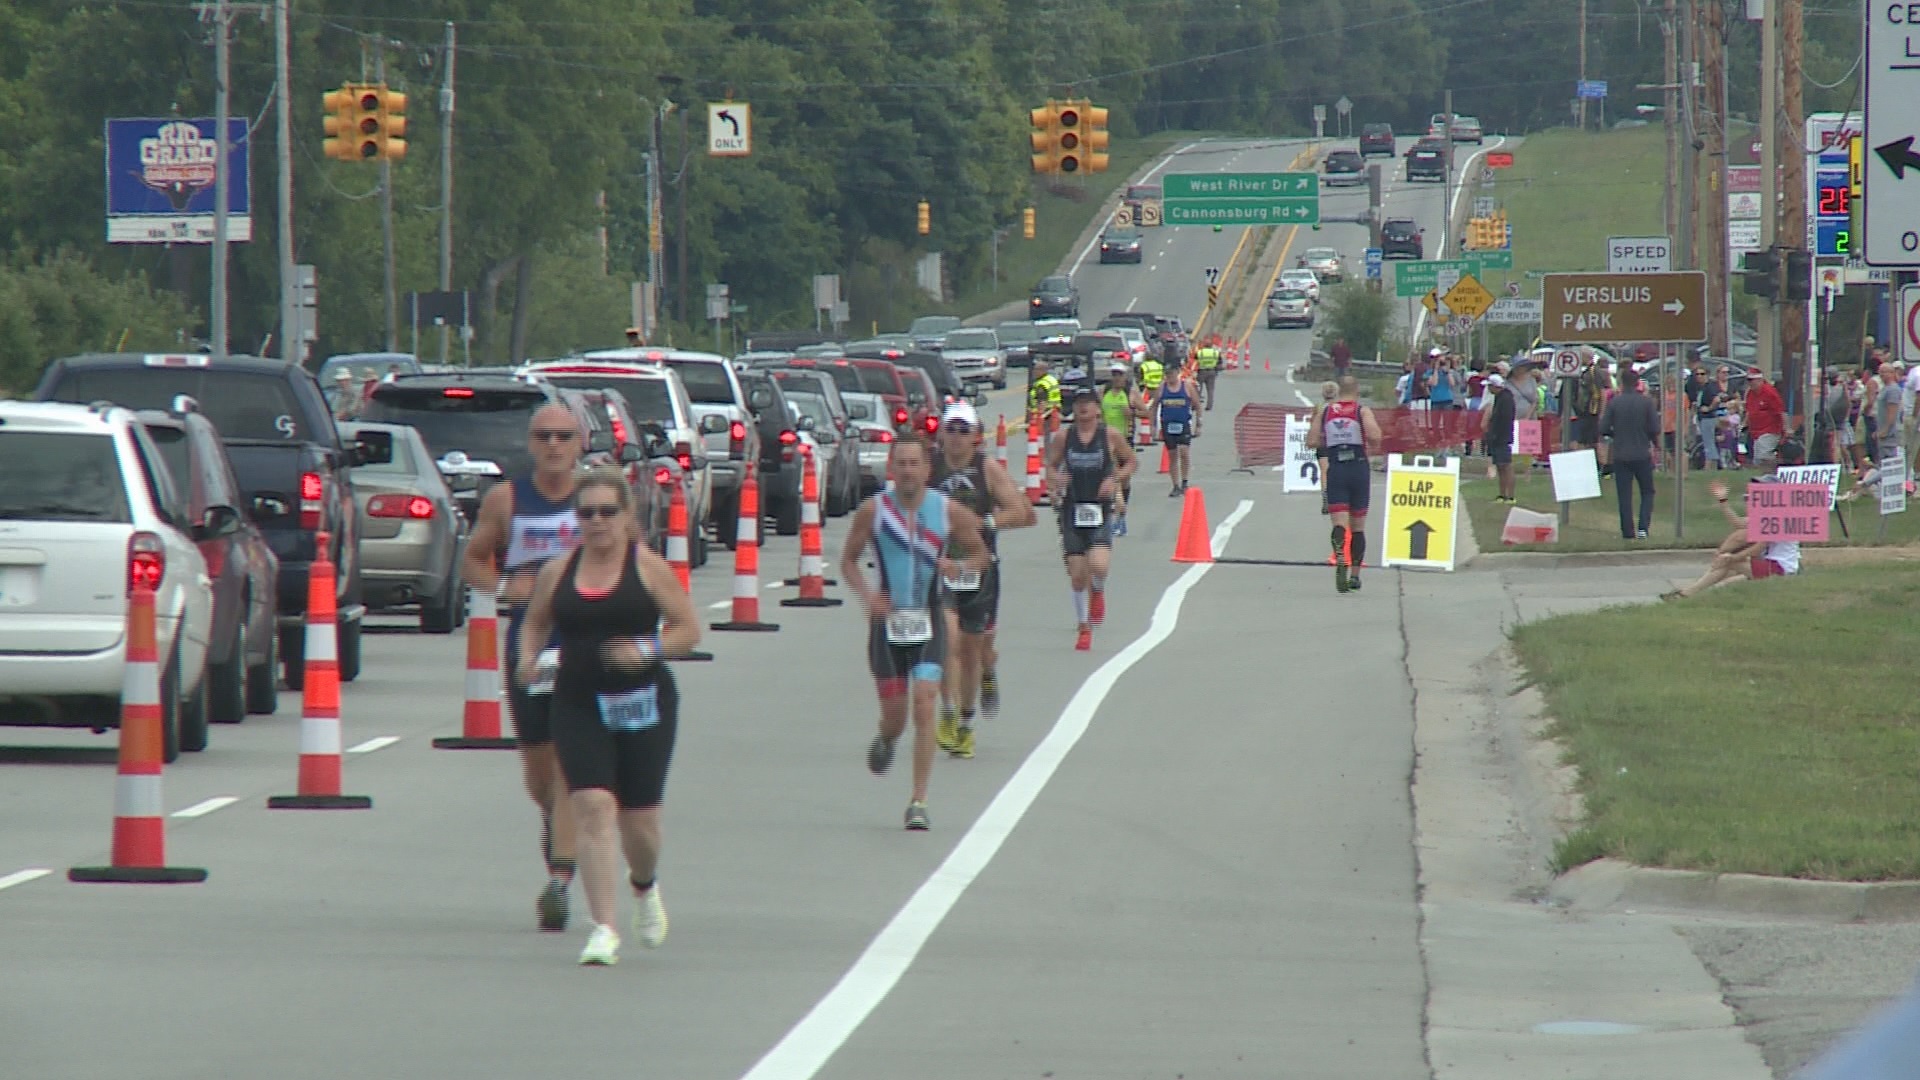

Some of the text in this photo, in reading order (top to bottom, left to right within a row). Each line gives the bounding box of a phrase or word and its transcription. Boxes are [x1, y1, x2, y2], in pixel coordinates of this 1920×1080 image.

[158, 121, 201, 146] RIO
[715, 138, 743, 148] ONLY
[1191, 178, 1289, 191] West River Dr
[1172, 206, 1290, 220] Cannonsburg Rd
[1613, 246, 1666, 259] SPEED
[1563, 286, 1652, 304] VERSLUIS
[1460, 306, 1476, 315] ICY
[1494, 301, 1535, 309] LEFT TURN
[1507, 312, 1530, 320] RIVER
[1563, 313, 1613, 330] PARK
[1780, 469, 1838, 486] NO RACE
[1408, 480, 1435, 493] LAP
[1391, 493, 1452, 509] COUNTER
[1752, 490, 1787, 508] FULL
[1790, 490, 1826, 508] IRON
[1760, 517, 1820, 535] 26 MILE
